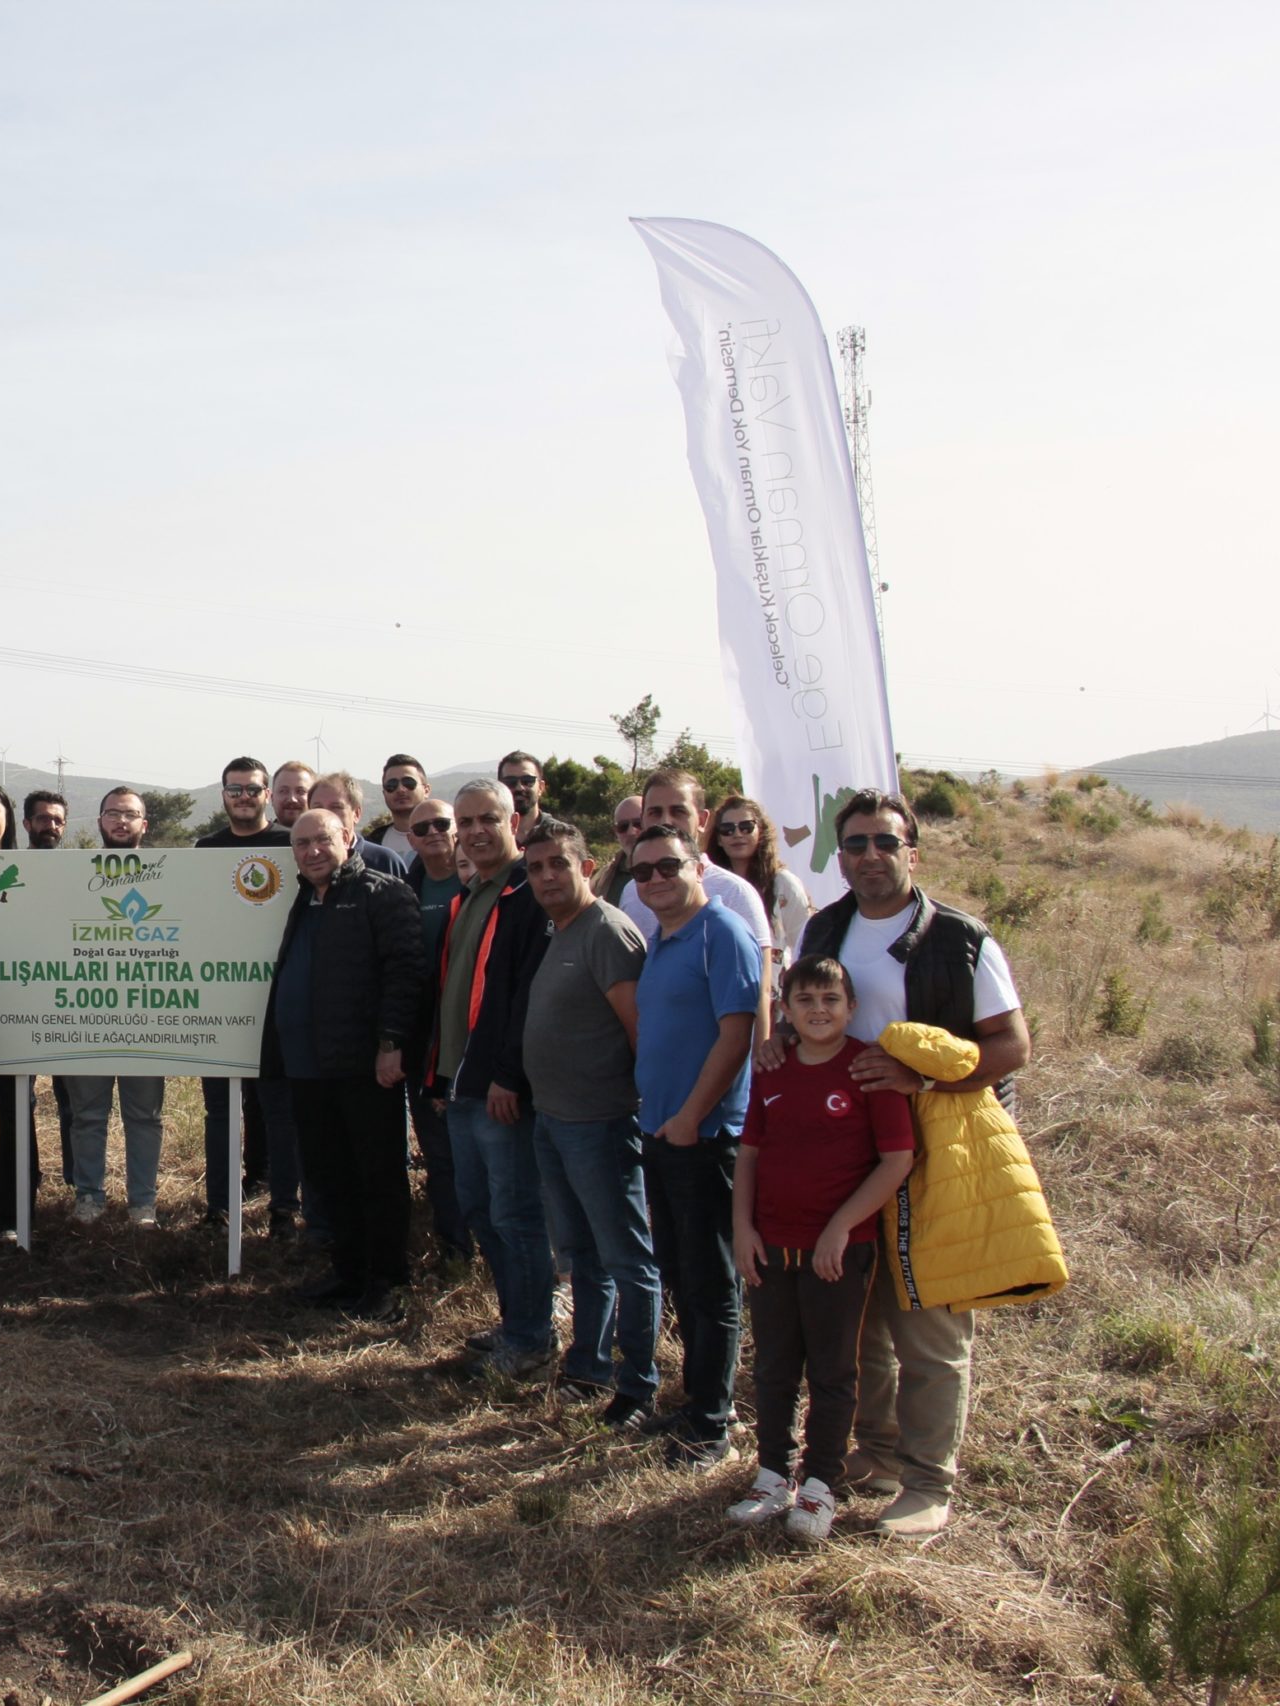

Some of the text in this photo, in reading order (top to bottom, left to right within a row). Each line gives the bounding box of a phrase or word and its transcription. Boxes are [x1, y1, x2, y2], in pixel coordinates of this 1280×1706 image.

[72, 924, 180, 942] İZMİRGAZ
[73, 948, 180, 959] Doğal Gaz Uygarlığı
[116, 961, 194, 982] HATIRA
[54, 984, 200, 1009] 5.000 FİDAN
[0, 1014, 39, 1025] ORMAN
[41, 1014, 77, 1025] GENEL
[79, 1013, 148, 1026] MÜDÜRLÜĞÜ
[157, 1015, 180, 1026] EGE
[182, 1015, 223, 1026] ORMAN
[225, 1016, 256, 1026] VAKFI
[31, 1031, 42, 1045] İŞ
[44, 1031, 82, 1043] BİRLİĞİ
[84, 1031, 100, 1043] İLE
[898, 1190, 909, 1227] YOURS
[898, 1231, 909, 1253] THE
